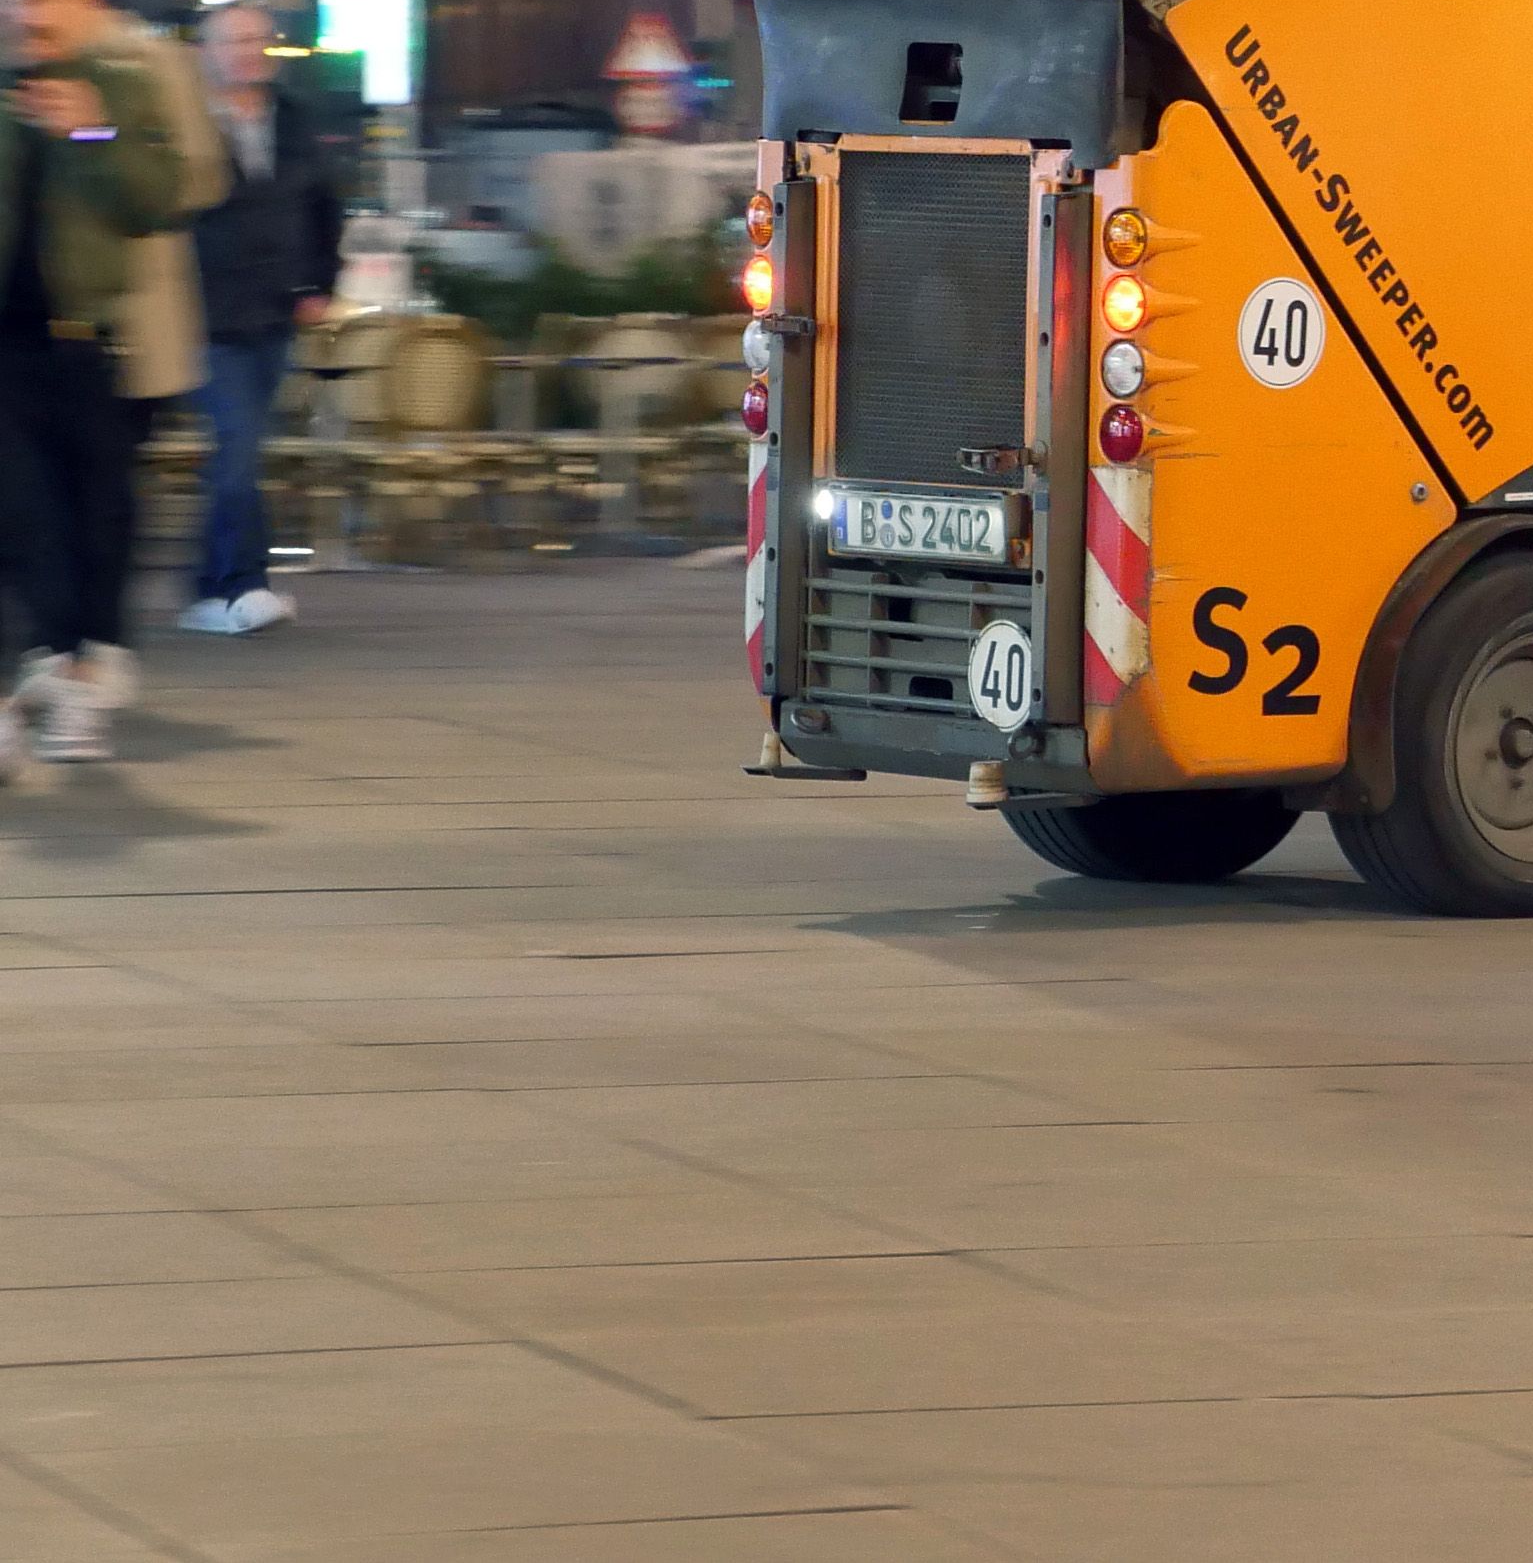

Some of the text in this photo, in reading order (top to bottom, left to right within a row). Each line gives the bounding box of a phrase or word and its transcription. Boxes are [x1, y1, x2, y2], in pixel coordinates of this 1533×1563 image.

[1252, 297, 1309, 369] 40
[980, 640, 1025, 712] 40
[1187, 586, 1322, 717] S2
